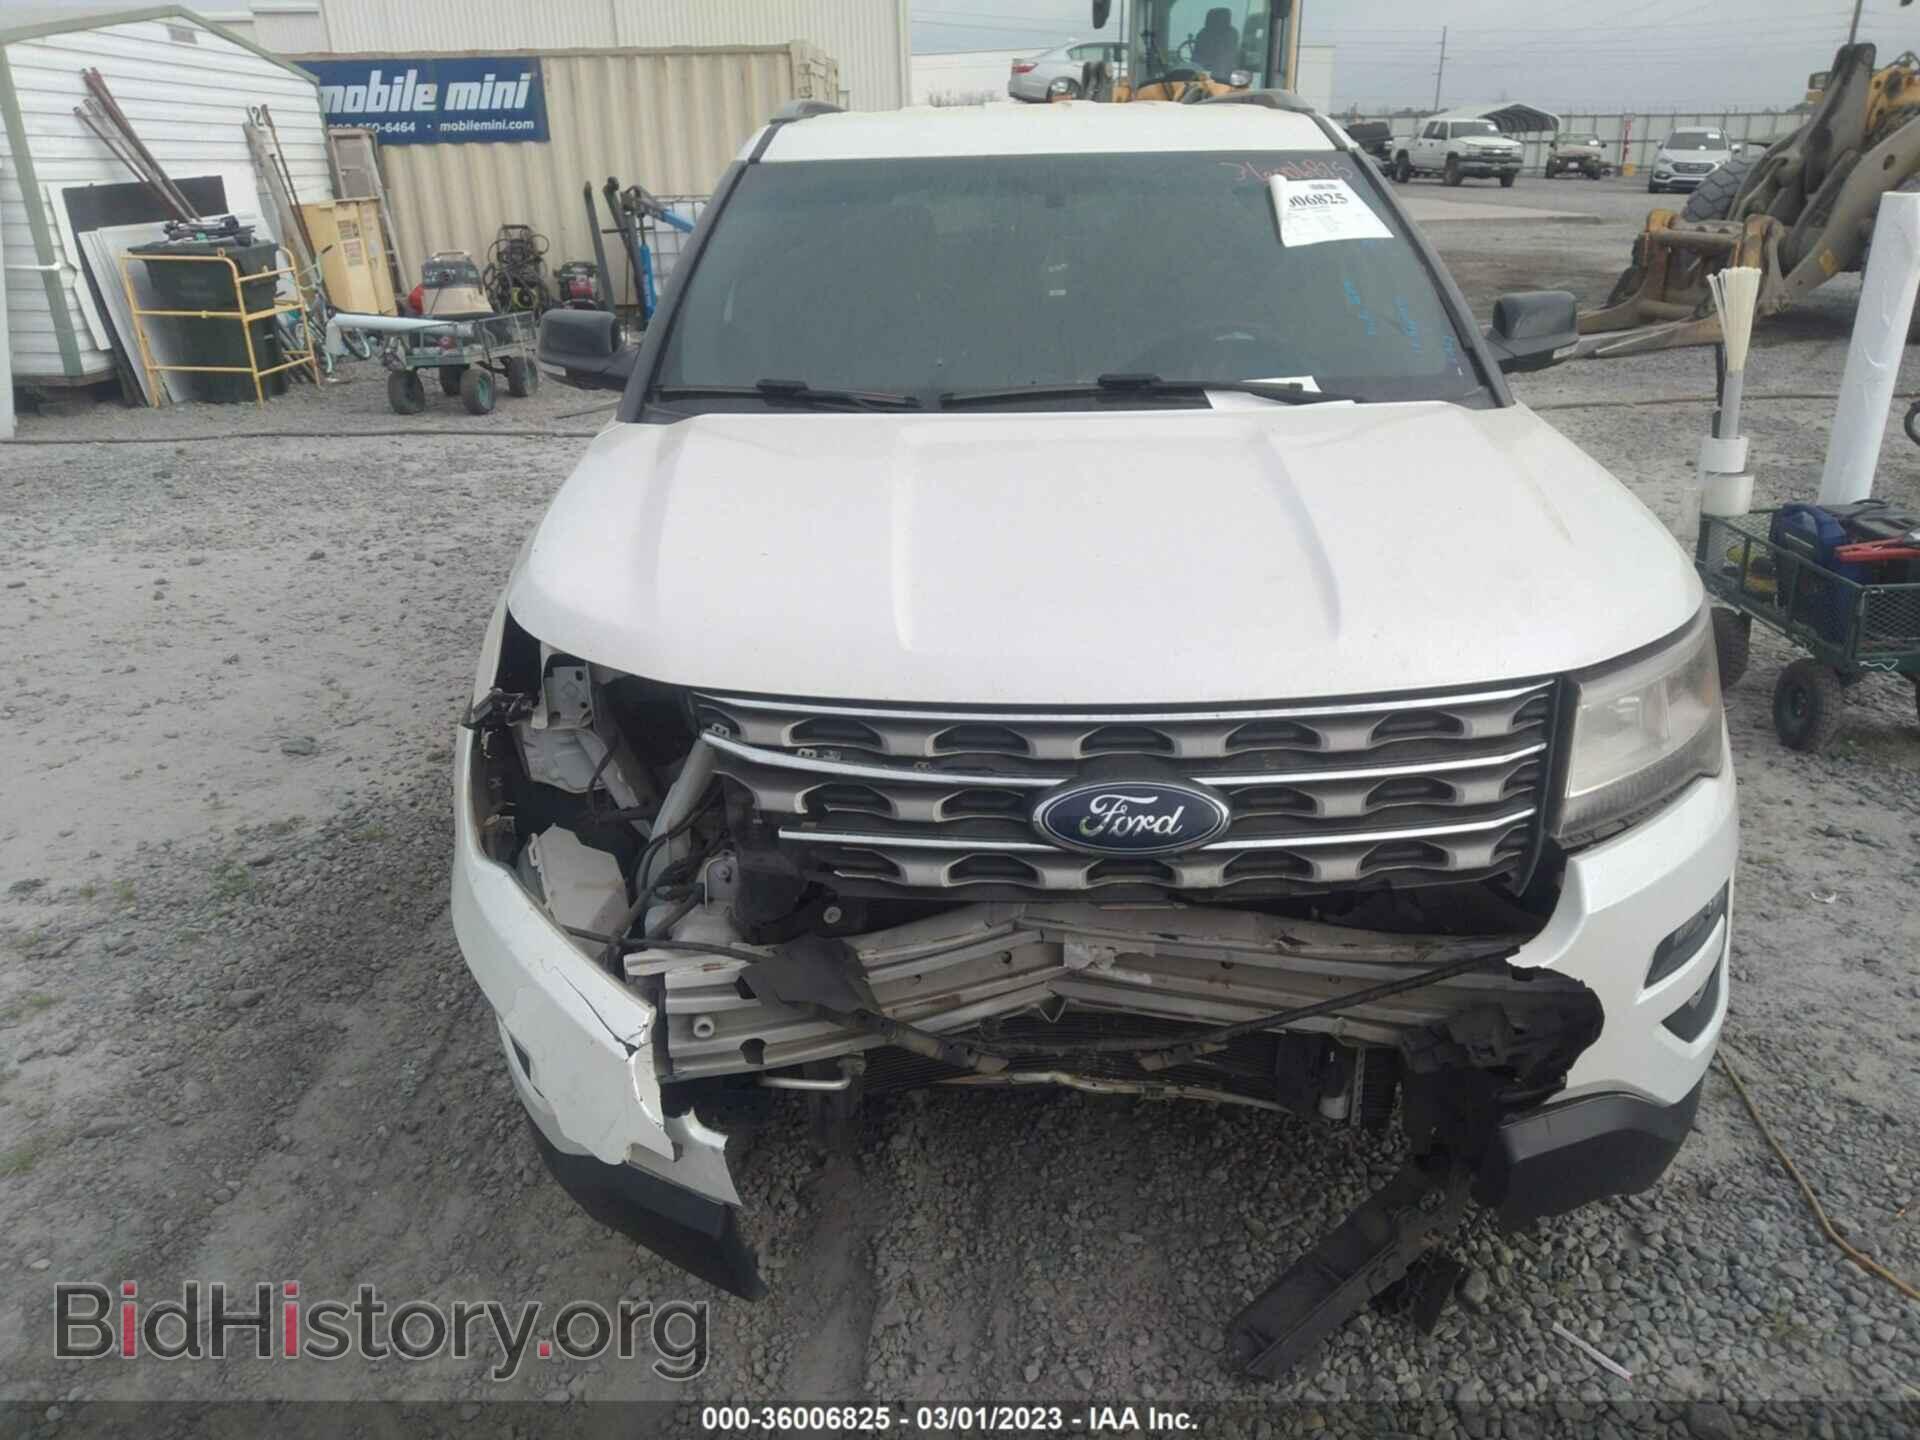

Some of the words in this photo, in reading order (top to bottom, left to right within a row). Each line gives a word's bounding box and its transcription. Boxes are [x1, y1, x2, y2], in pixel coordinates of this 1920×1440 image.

[444, 72, 532, 111] mini
[440, 118, 535, 132] mobilemini.com
[1079, 794, 1185, 837] Ford
